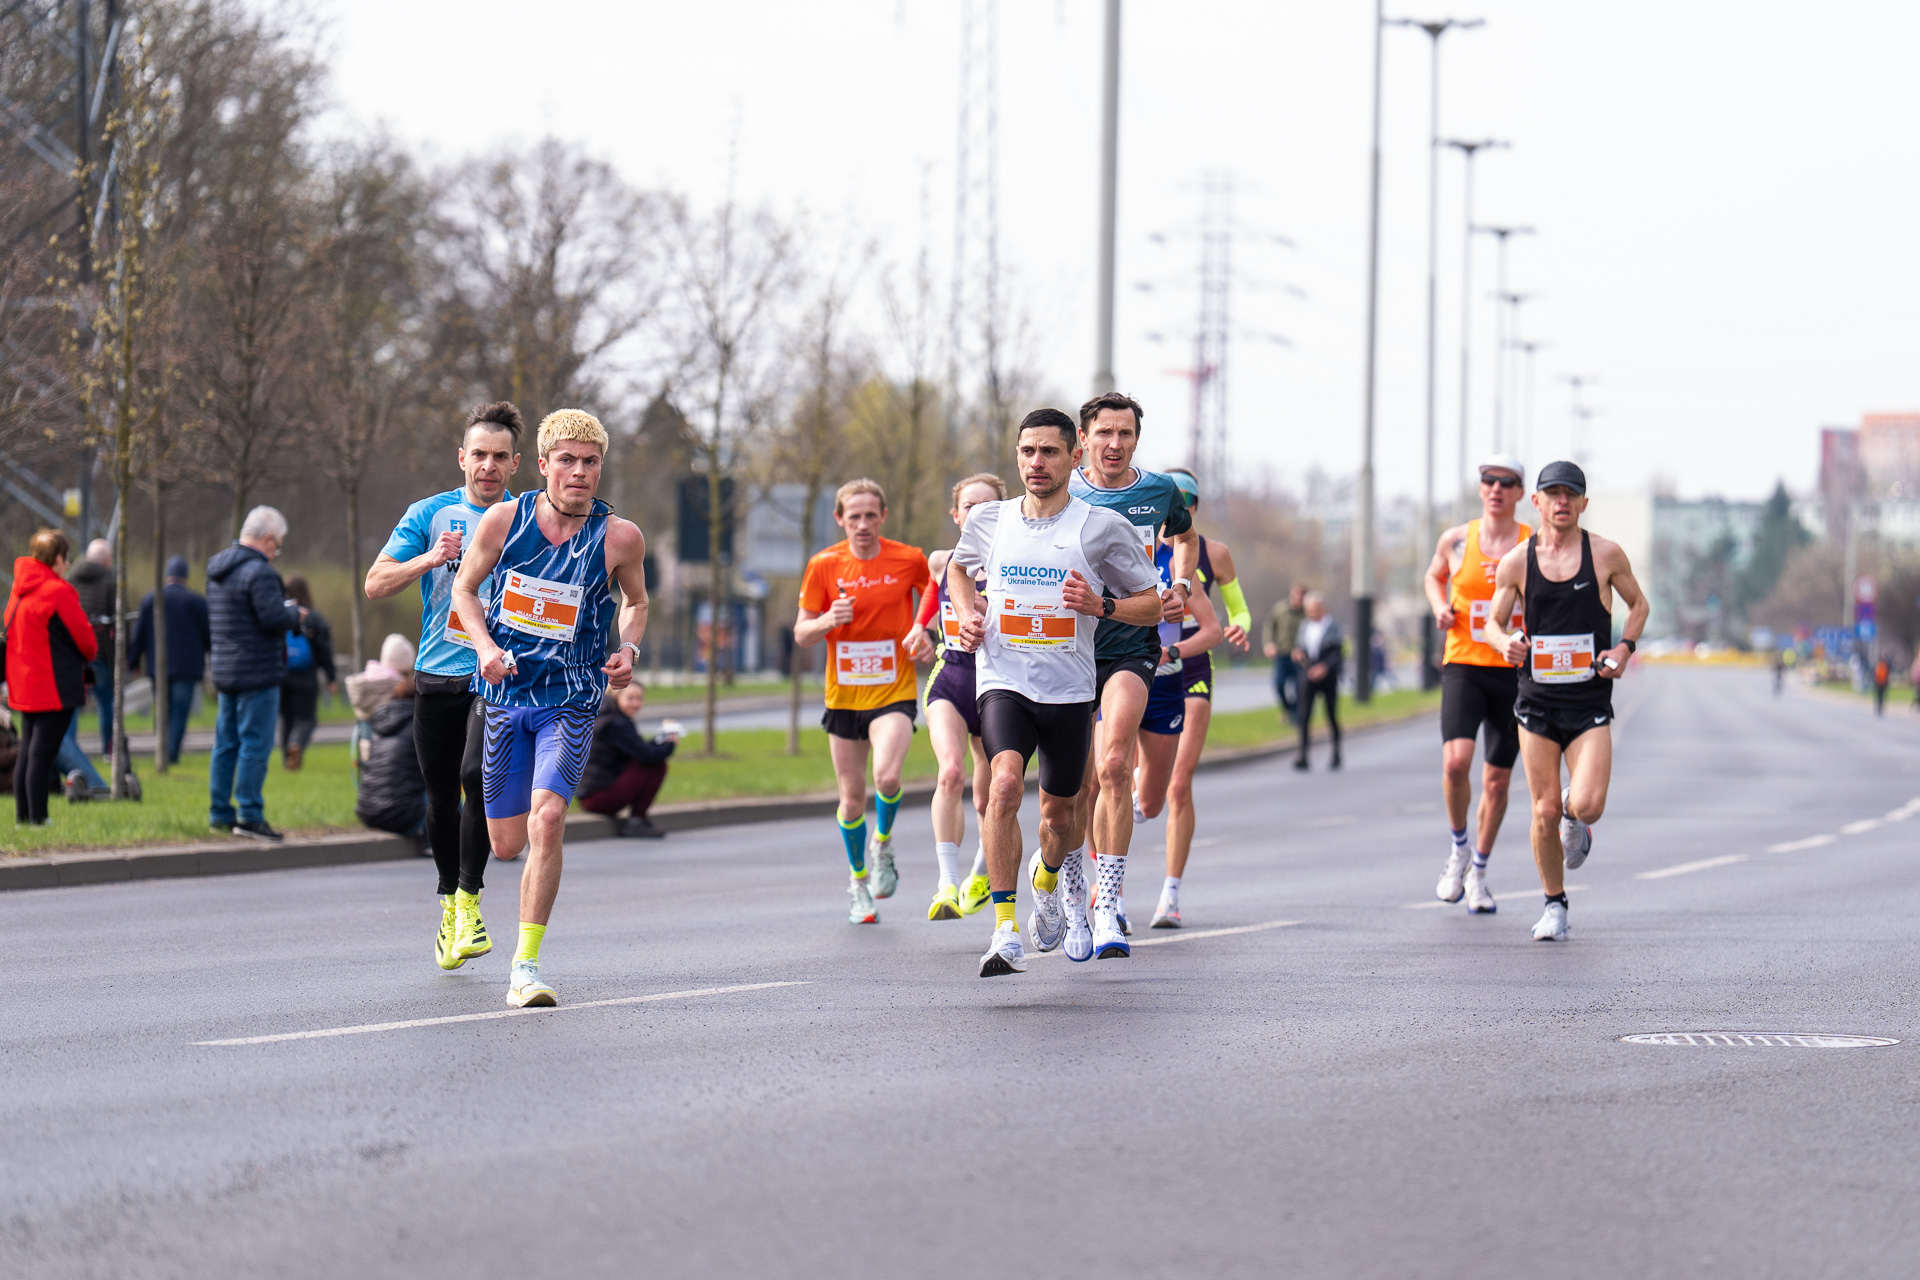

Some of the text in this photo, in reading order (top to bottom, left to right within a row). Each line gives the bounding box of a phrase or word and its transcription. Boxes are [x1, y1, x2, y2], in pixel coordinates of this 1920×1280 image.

[1001, 565, 1067, 582] saucony
[1036, 579, 1057, 587] Team
[533, 599, 546, 616] 8
[1031, 617, 1043, 633] 9
[850, 657, 883, 673] 322
[1552, 653, 1572, 667] 28
